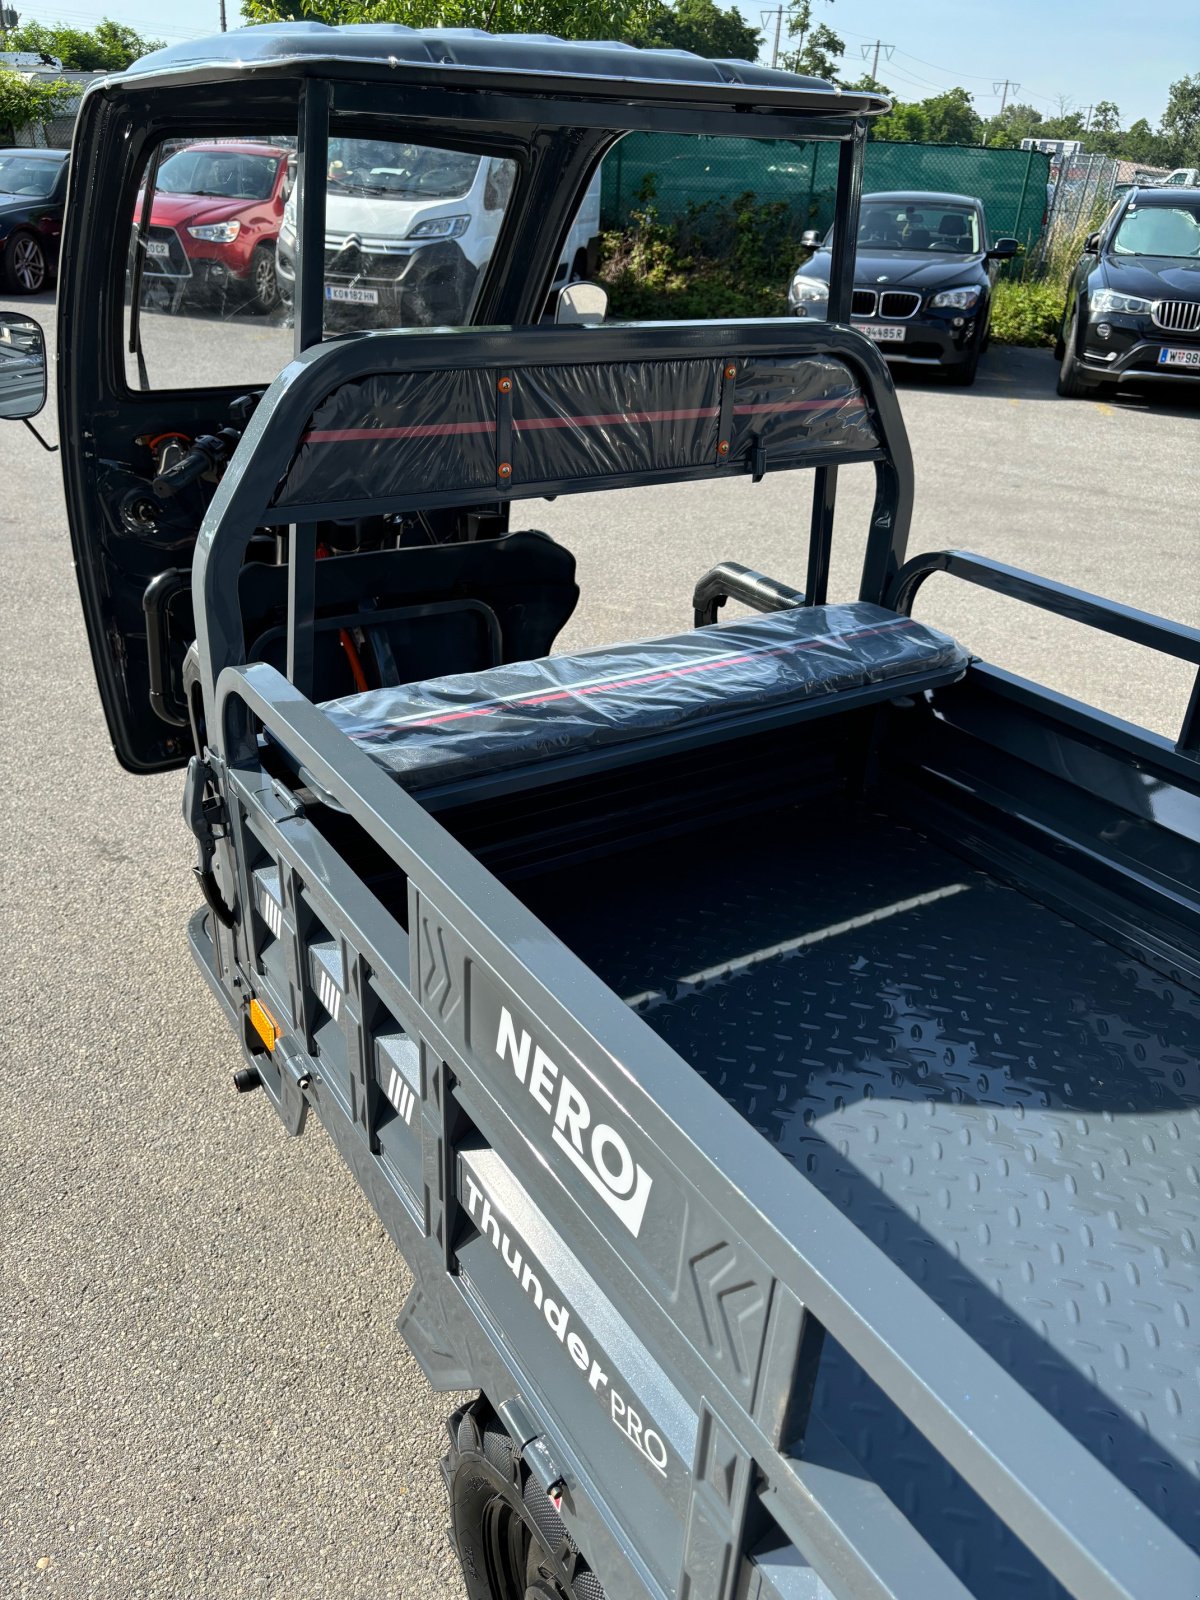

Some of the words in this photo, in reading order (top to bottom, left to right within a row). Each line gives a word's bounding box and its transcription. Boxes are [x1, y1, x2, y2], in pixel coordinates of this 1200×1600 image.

[1185, 352, 1200, 364] 98
[495, 1005, 635, 1197] NERO
[465, 1174, 608, 1391] Thunder
[610, 1388, 668, 1470] PRO
